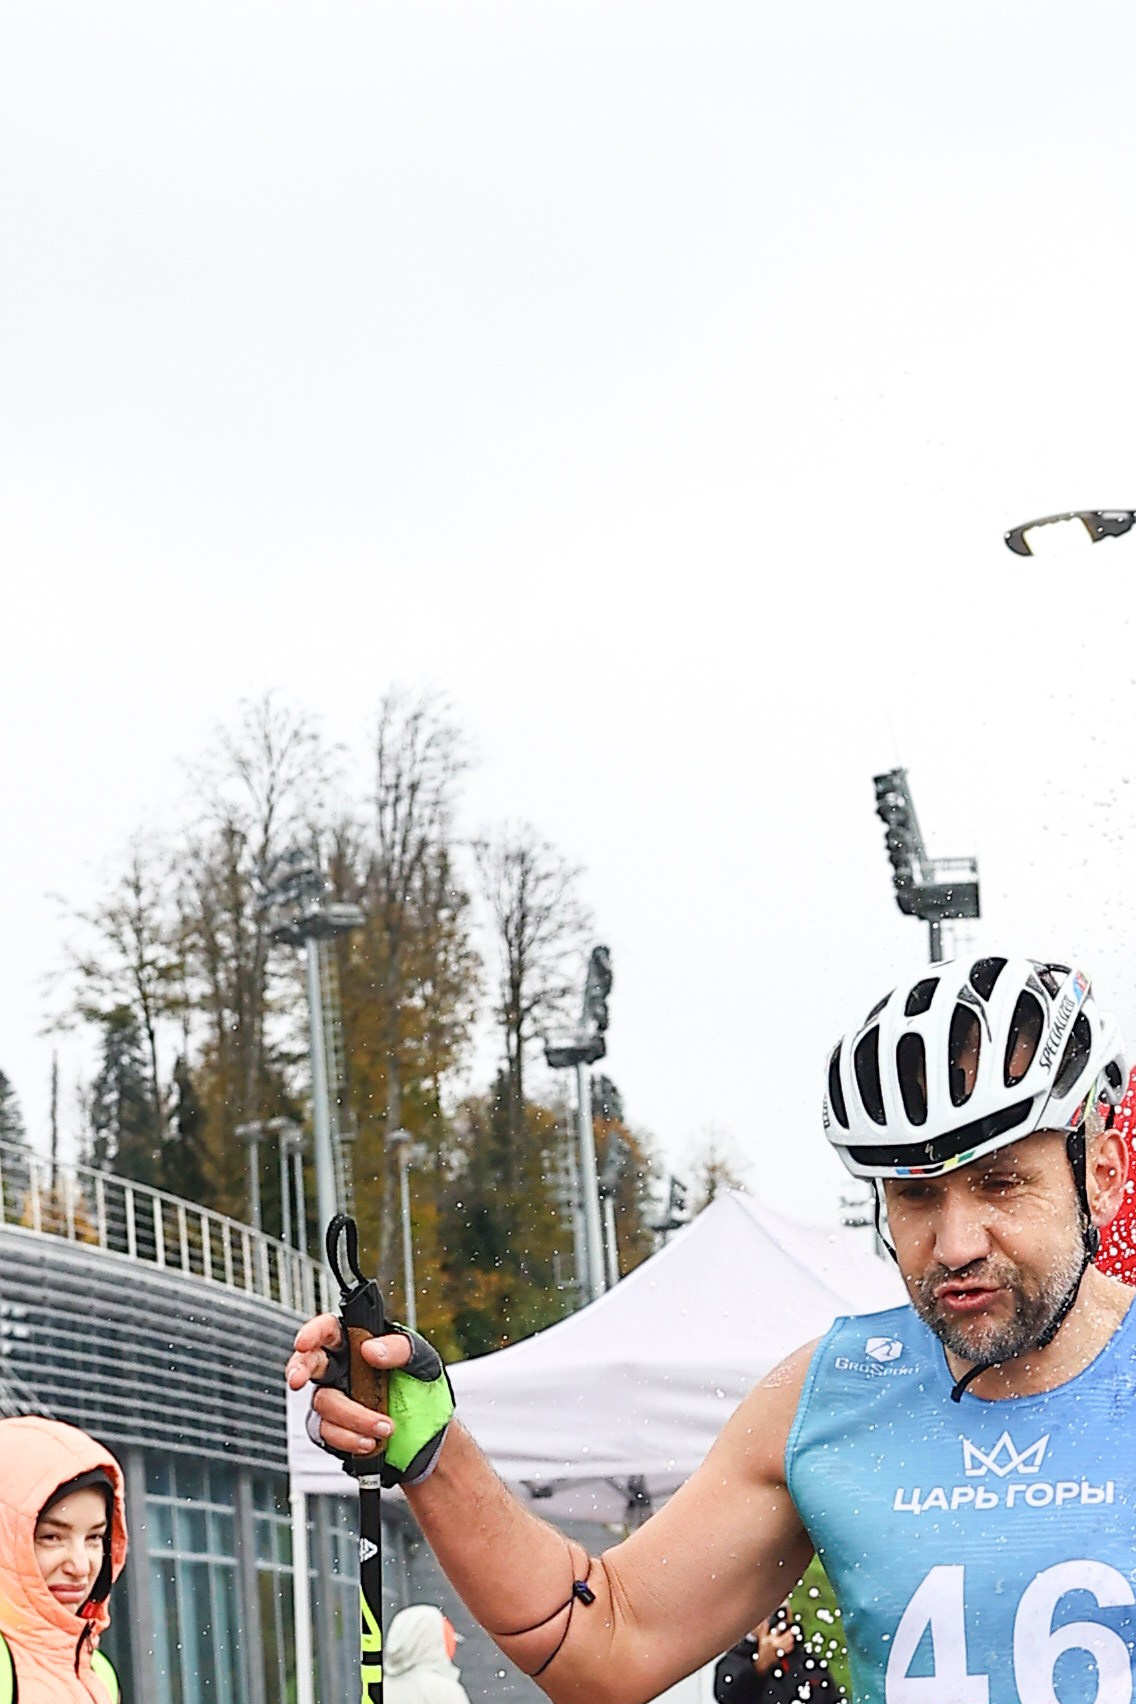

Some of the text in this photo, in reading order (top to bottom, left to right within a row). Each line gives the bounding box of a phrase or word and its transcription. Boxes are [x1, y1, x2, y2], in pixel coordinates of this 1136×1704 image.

[1039, 995, 1075, 1070] SPECIALIZED
[893, 1480, 1115, 1515] ЦАРЬ ГОРЫ
